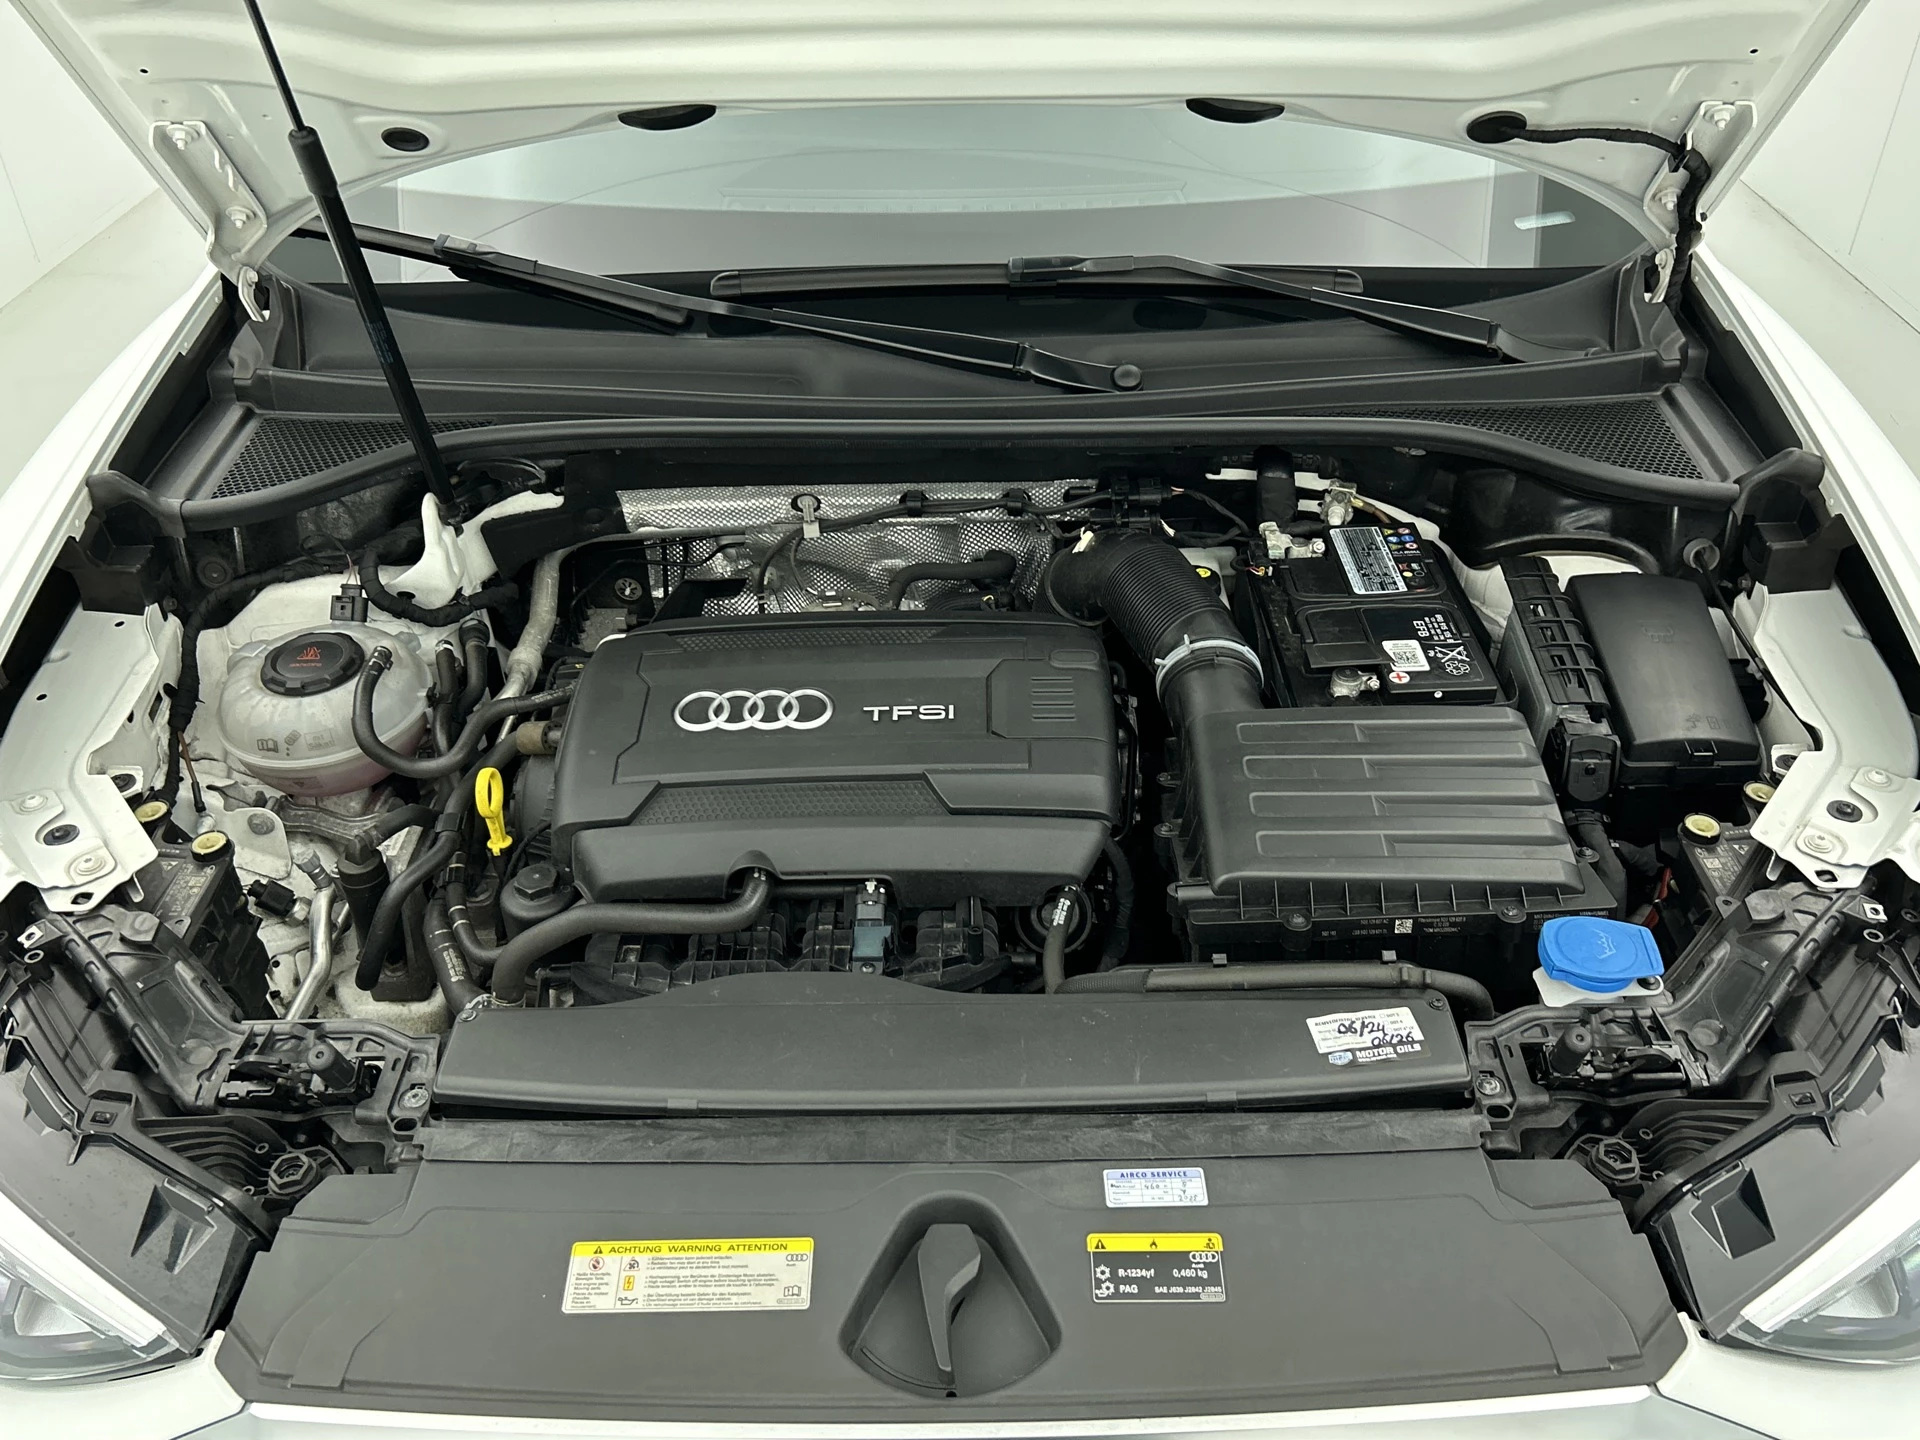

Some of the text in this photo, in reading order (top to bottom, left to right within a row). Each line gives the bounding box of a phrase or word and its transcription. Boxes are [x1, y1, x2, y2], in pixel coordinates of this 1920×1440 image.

[1412, 620, 1430, 637] EFB
[863, 704, 956, 721] TFSI
[1337, 1020, 1387, 1038] 06/24
[1371, 1031, 1414, 1048] 06/26
[1356, 1043, 1421, 1058] MOTOR OILS
[609, 1243, 789, 1254] ACHTUNG WARNING ATTENTION
[1118, 1268, 1155, 1279] R-1234yf
[1197, 1268, 1209, 1279] kg
[1119, 1284, 1139, 1294] PAG
